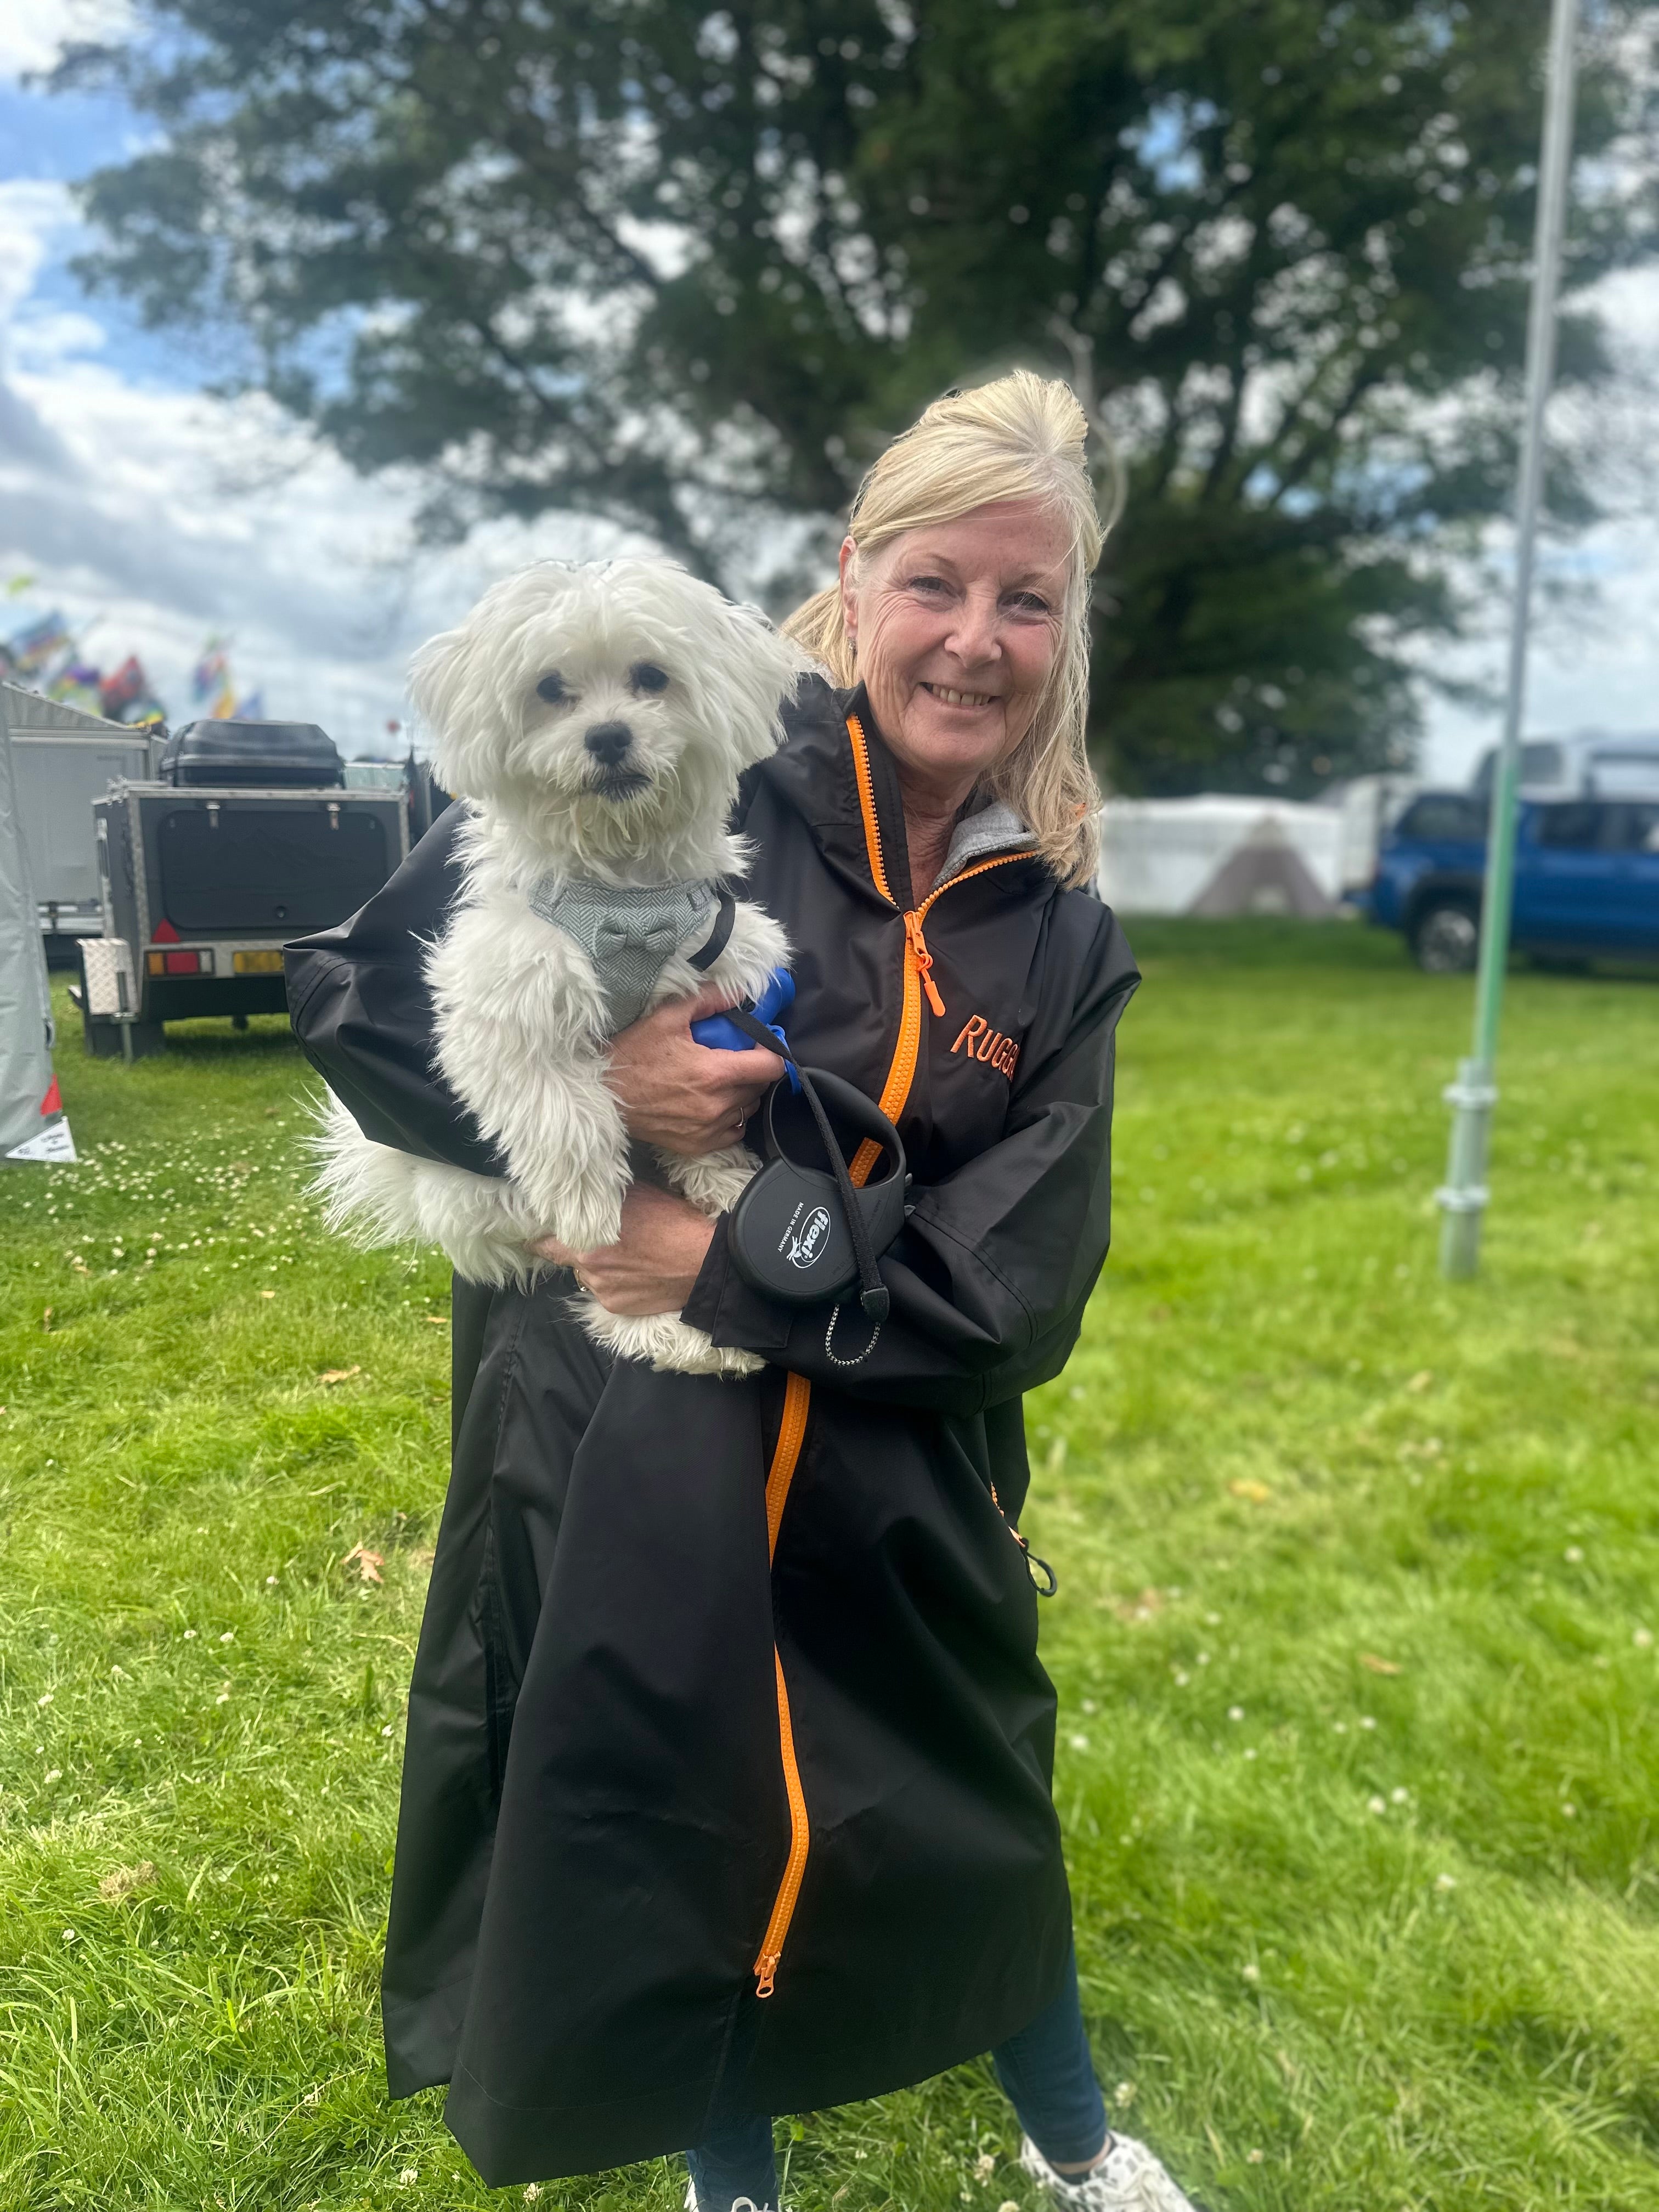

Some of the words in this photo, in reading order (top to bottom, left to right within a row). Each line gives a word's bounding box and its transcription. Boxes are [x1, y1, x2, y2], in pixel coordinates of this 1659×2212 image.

[793, 1202, 804, 1218] MADE
[777, 1226, 793, 1252] GERMANY
[801, 1210, 828, 1259] flexi
